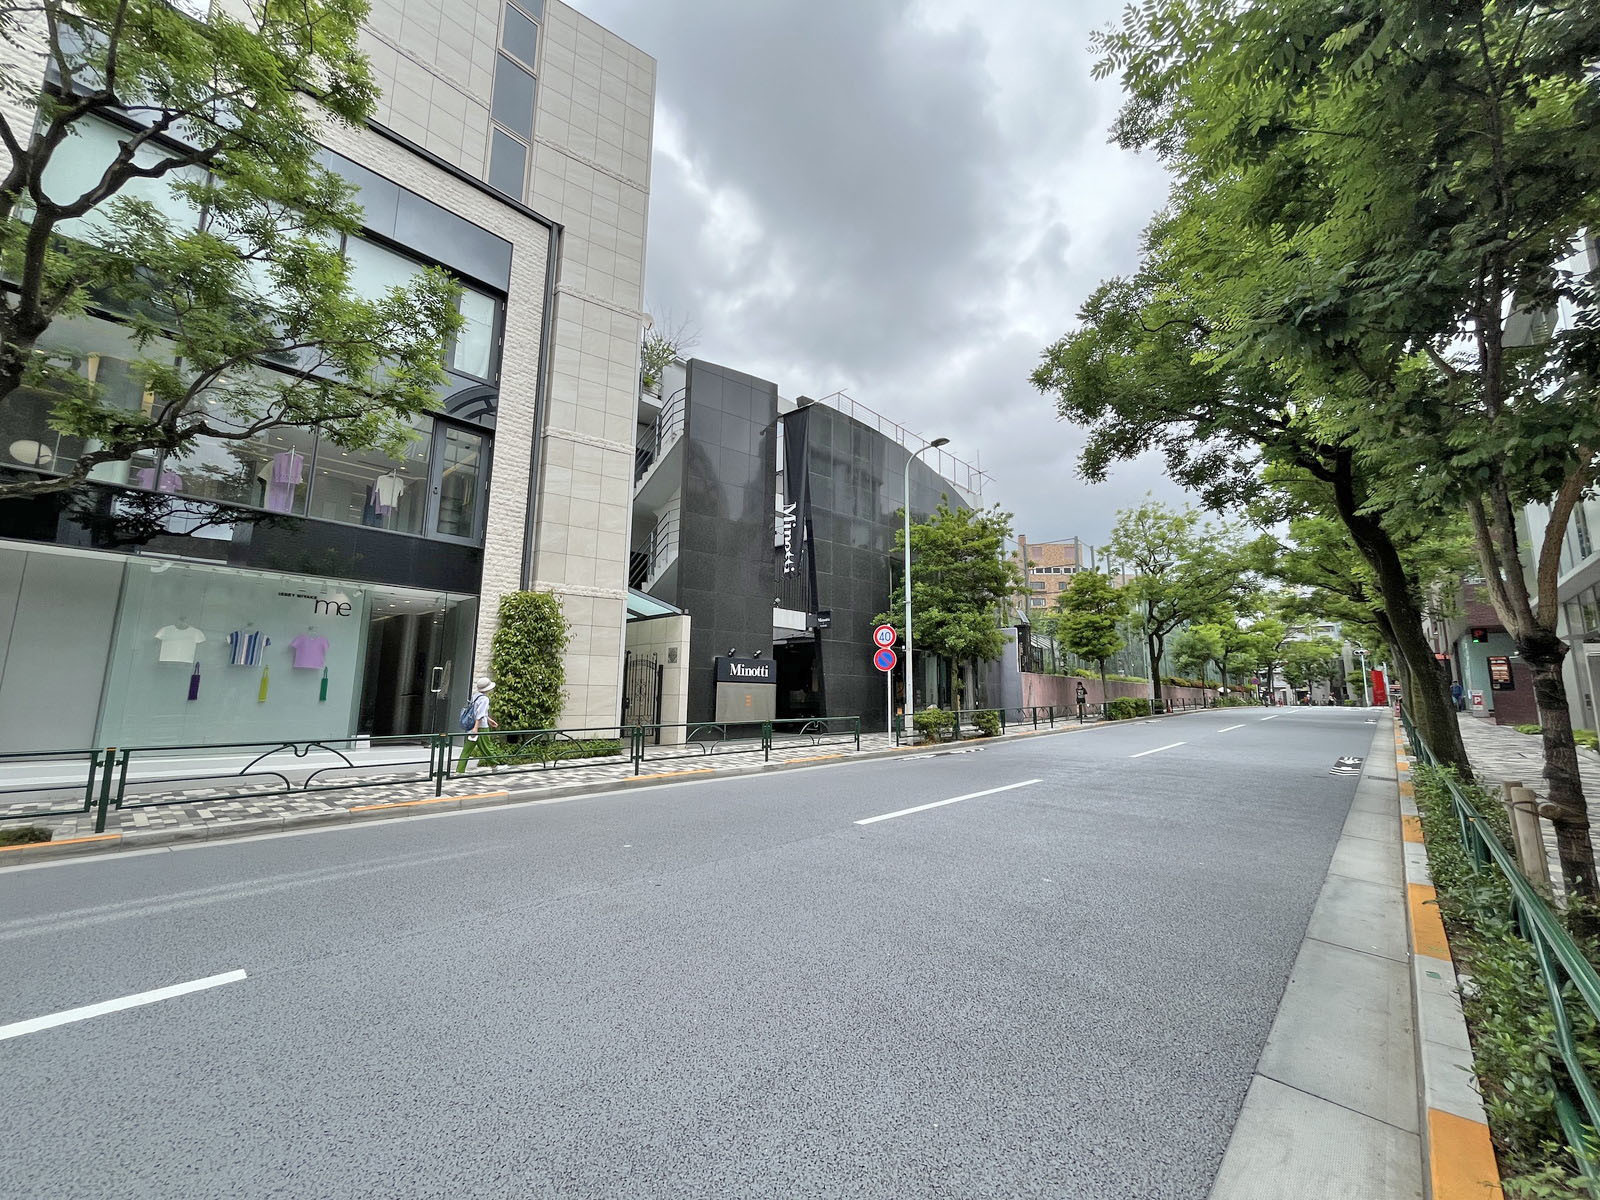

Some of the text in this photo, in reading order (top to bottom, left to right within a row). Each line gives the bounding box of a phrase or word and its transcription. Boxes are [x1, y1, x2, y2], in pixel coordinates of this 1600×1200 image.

[783, 501, 797, 574] Minotti
[314, 599, 352, 617] me
[879, 631, 892, 642] 40
[730, 663, 769, 677] Minotti
[1474, 696, 1481, 704] P
